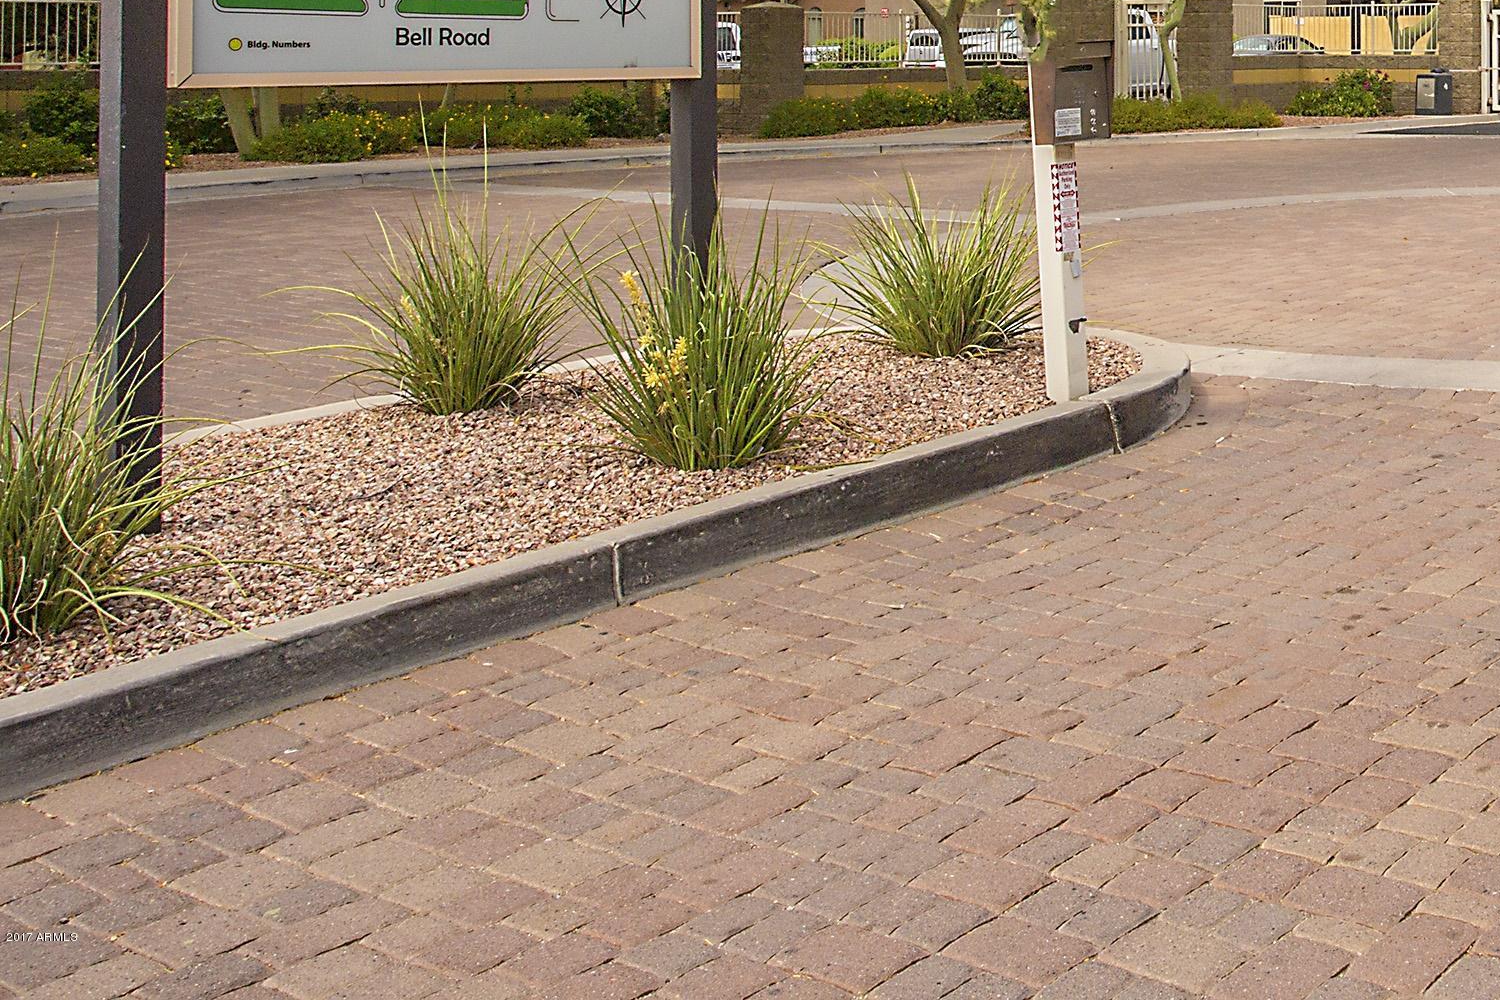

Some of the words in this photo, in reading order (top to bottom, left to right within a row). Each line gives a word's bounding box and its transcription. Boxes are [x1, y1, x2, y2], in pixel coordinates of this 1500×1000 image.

[395, 28, 432, 46] Bell
[439, 28, 490, 46] Road
[247, 40, 269, 50] Bldg.
[272, 40, 311, 49] Numbers
